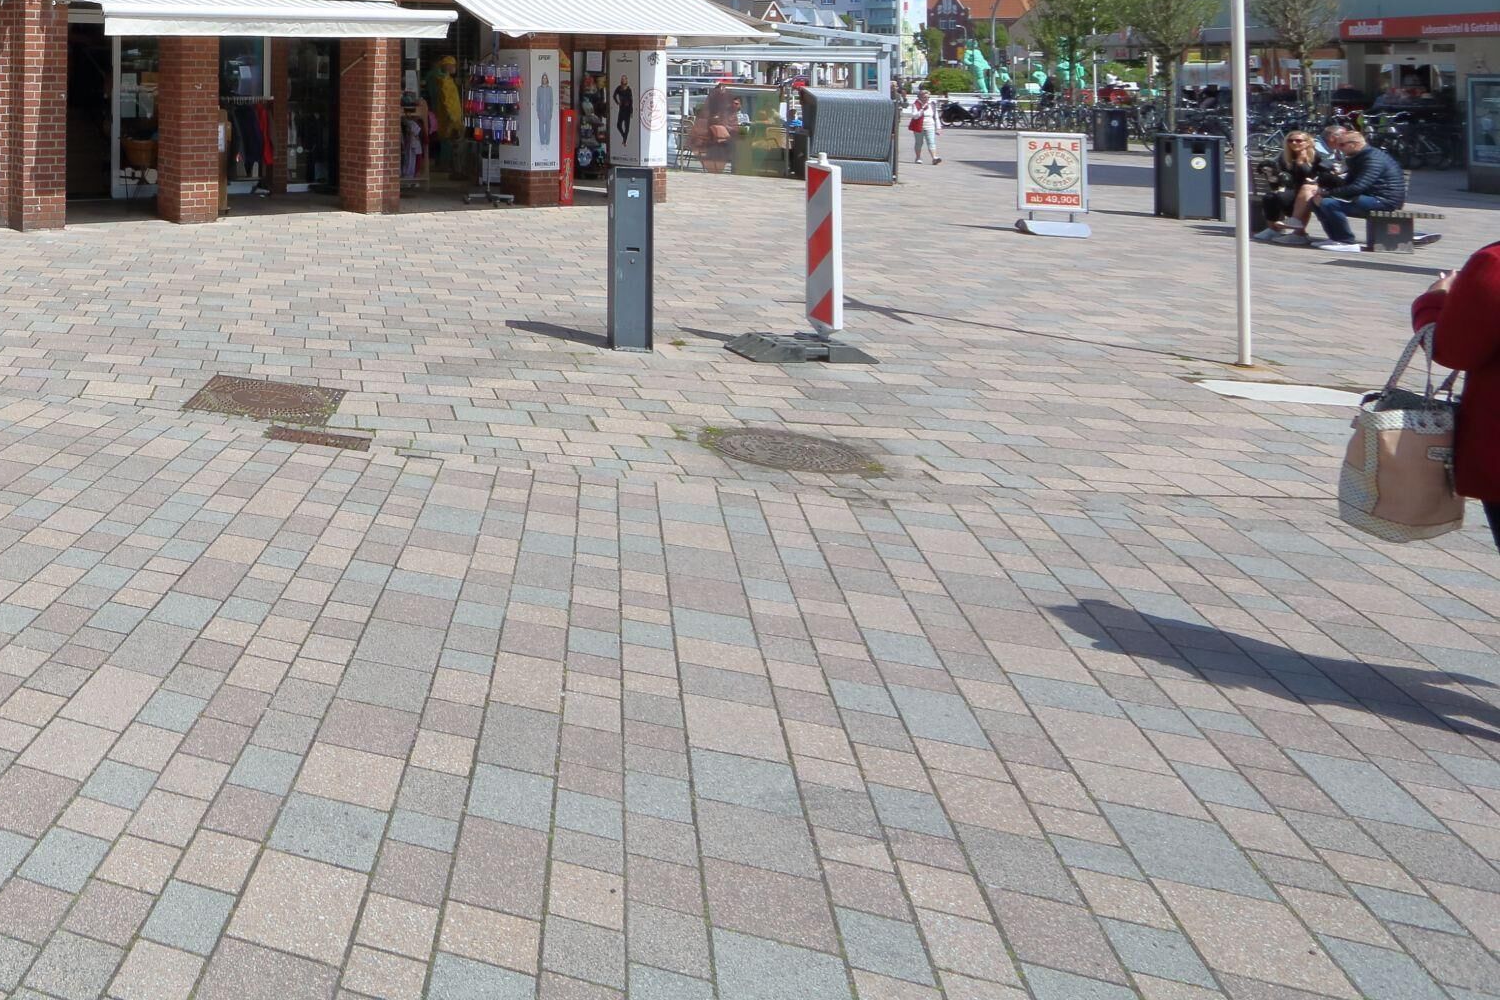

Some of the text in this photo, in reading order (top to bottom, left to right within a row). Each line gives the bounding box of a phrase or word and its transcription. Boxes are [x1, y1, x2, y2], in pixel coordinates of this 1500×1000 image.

[1421, 23, 1463, 34] Lebensmittel
[1028, 141, 1079, 152] SALE
[1036, 151, 1074, 166] CONVERSE
[1053, 176, 1073, 187] STAR
[1030, 194, 1044, 203] ab
